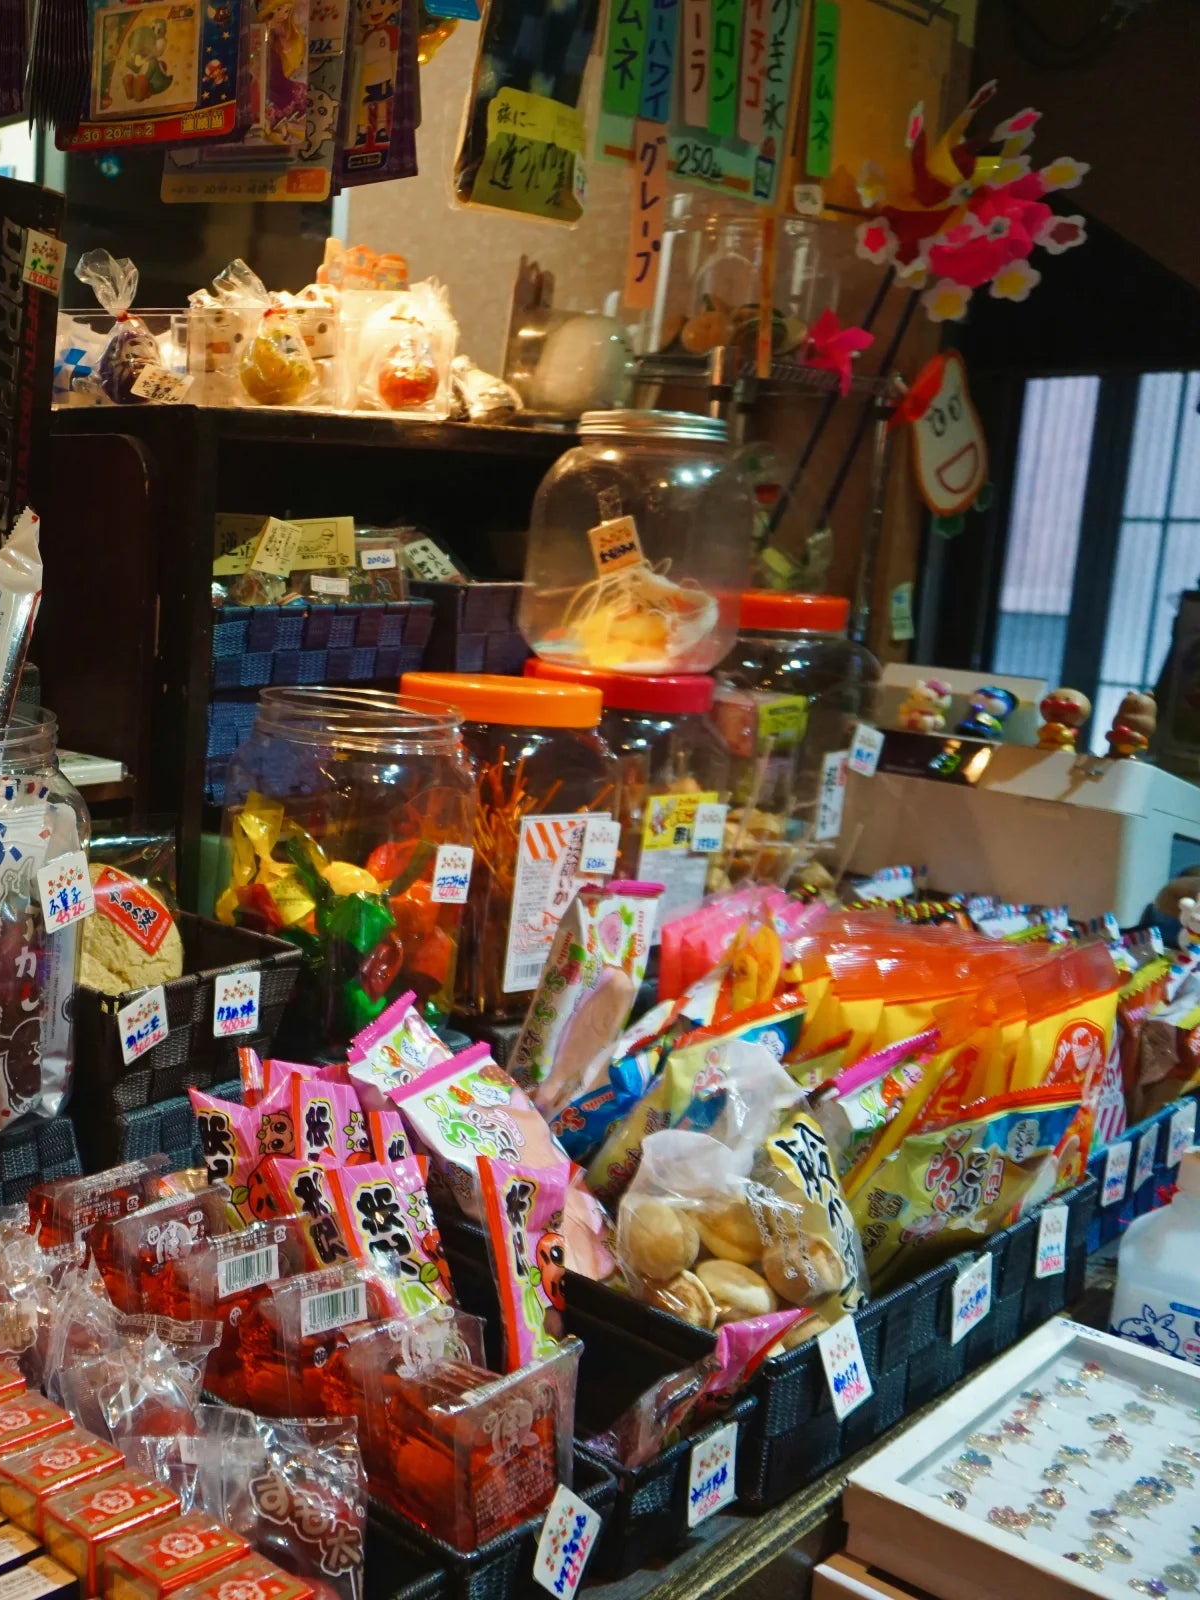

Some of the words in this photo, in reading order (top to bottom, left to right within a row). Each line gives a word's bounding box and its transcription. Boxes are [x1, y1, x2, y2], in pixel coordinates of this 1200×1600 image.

[810, 30, 836, 150] ラムネ
[634, 136, 668, 284] グレープ
